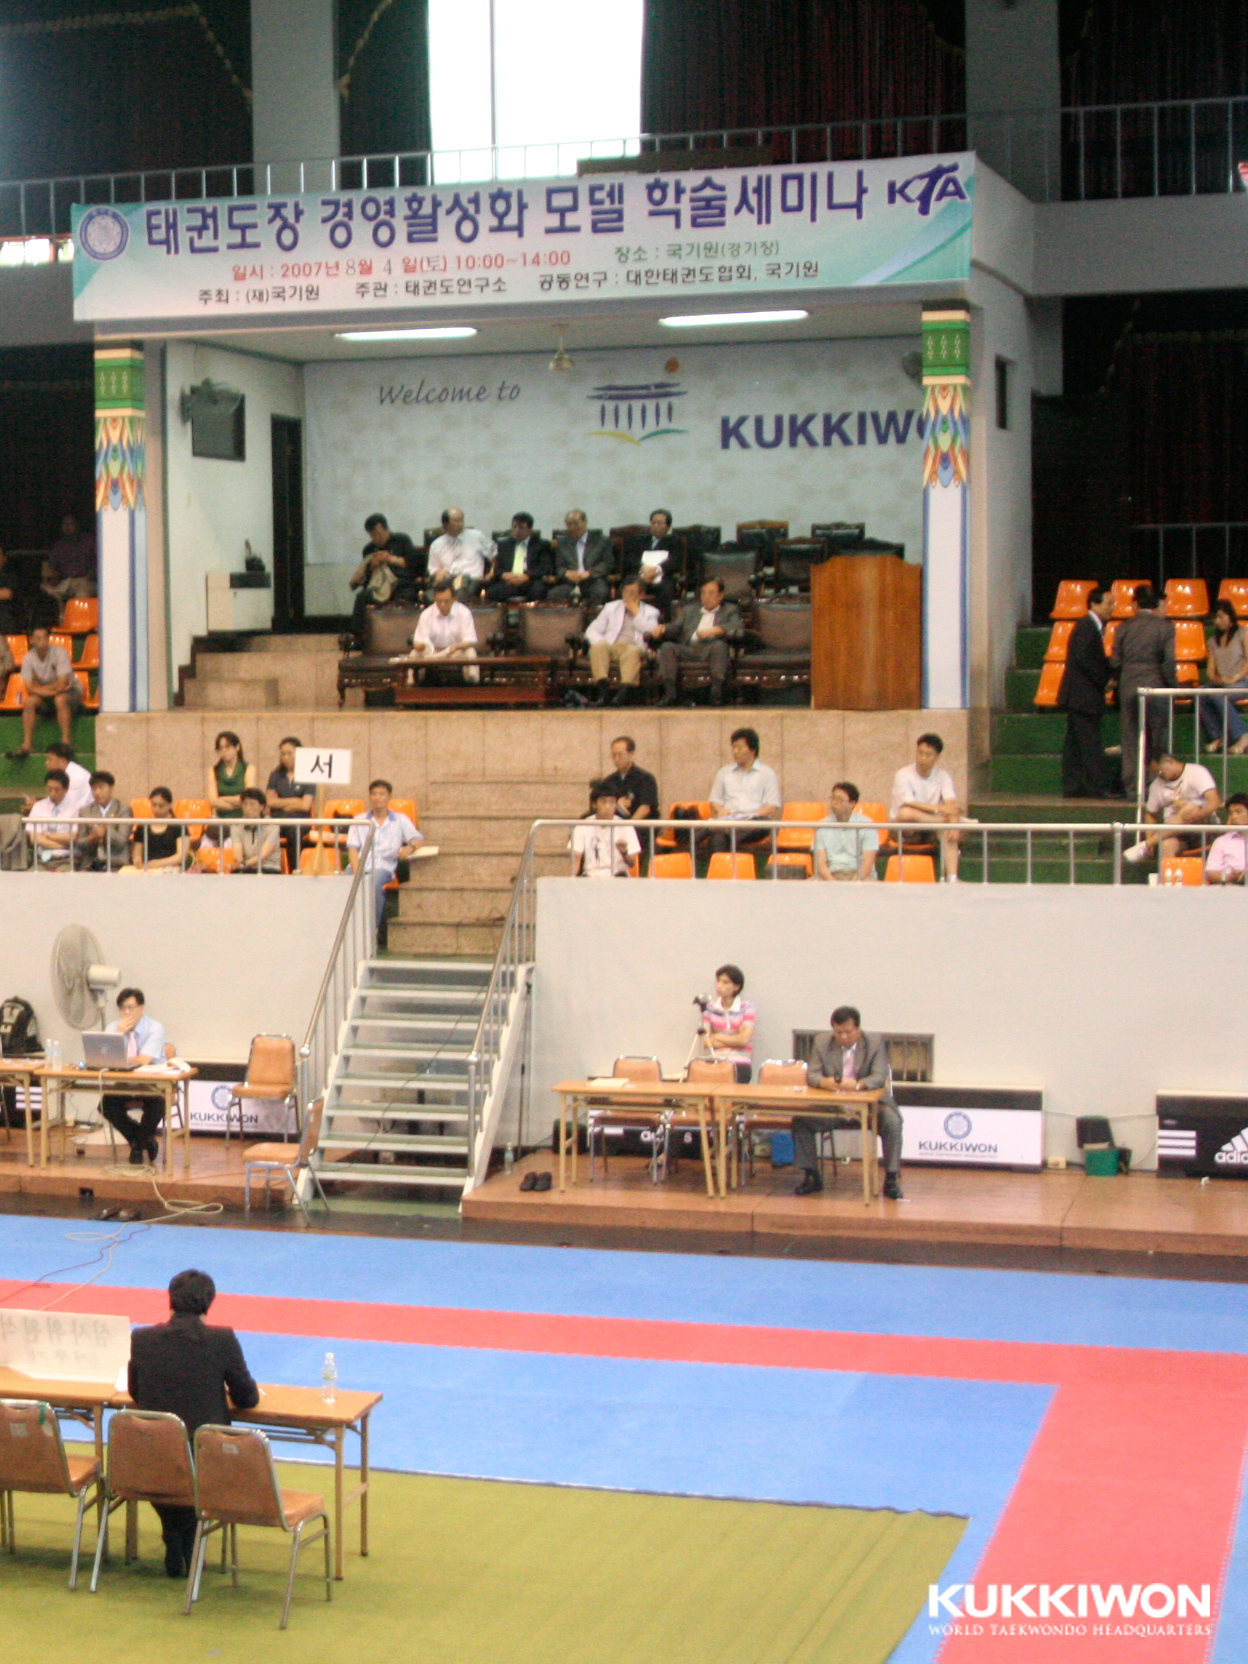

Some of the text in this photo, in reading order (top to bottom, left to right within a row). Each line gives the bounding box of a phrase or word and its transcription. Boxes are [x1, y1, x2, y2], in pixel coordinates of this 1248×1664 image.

[887, 162, 967, 216] KTA
[145, 200, 305, 255] 태권도장
[320, 187, 529, 249] 경영활성화
[544, 182, 625, 234] 모델
[645, 169, 869, 230] 학술세미나
[615, 245, 648, 263] 장소
[667, 240, 780, 260] 국기원(경기장)
[232, 264, 264, 281] 일시
[280, 261, 340, 278] 2007년
[456, 250, 571, 271] 10:00~14:00
[539, 271, 608, 291] 공동연구
[765, 261, 819, 280] 국기원
[199, 288, 229, 305] 주최
[246, 284, 320, 303] (재)국기원
[355, 281, 388, 298] 주관
[405, 277, 508, 297] 태권도연구소
[379, 378, 521, 405] Welcome to
[720, 409, 926, 450] KUKKIW
[310, 754, 333, 779] 서
[918, 1140, 998, 1153] KUKKIWON
